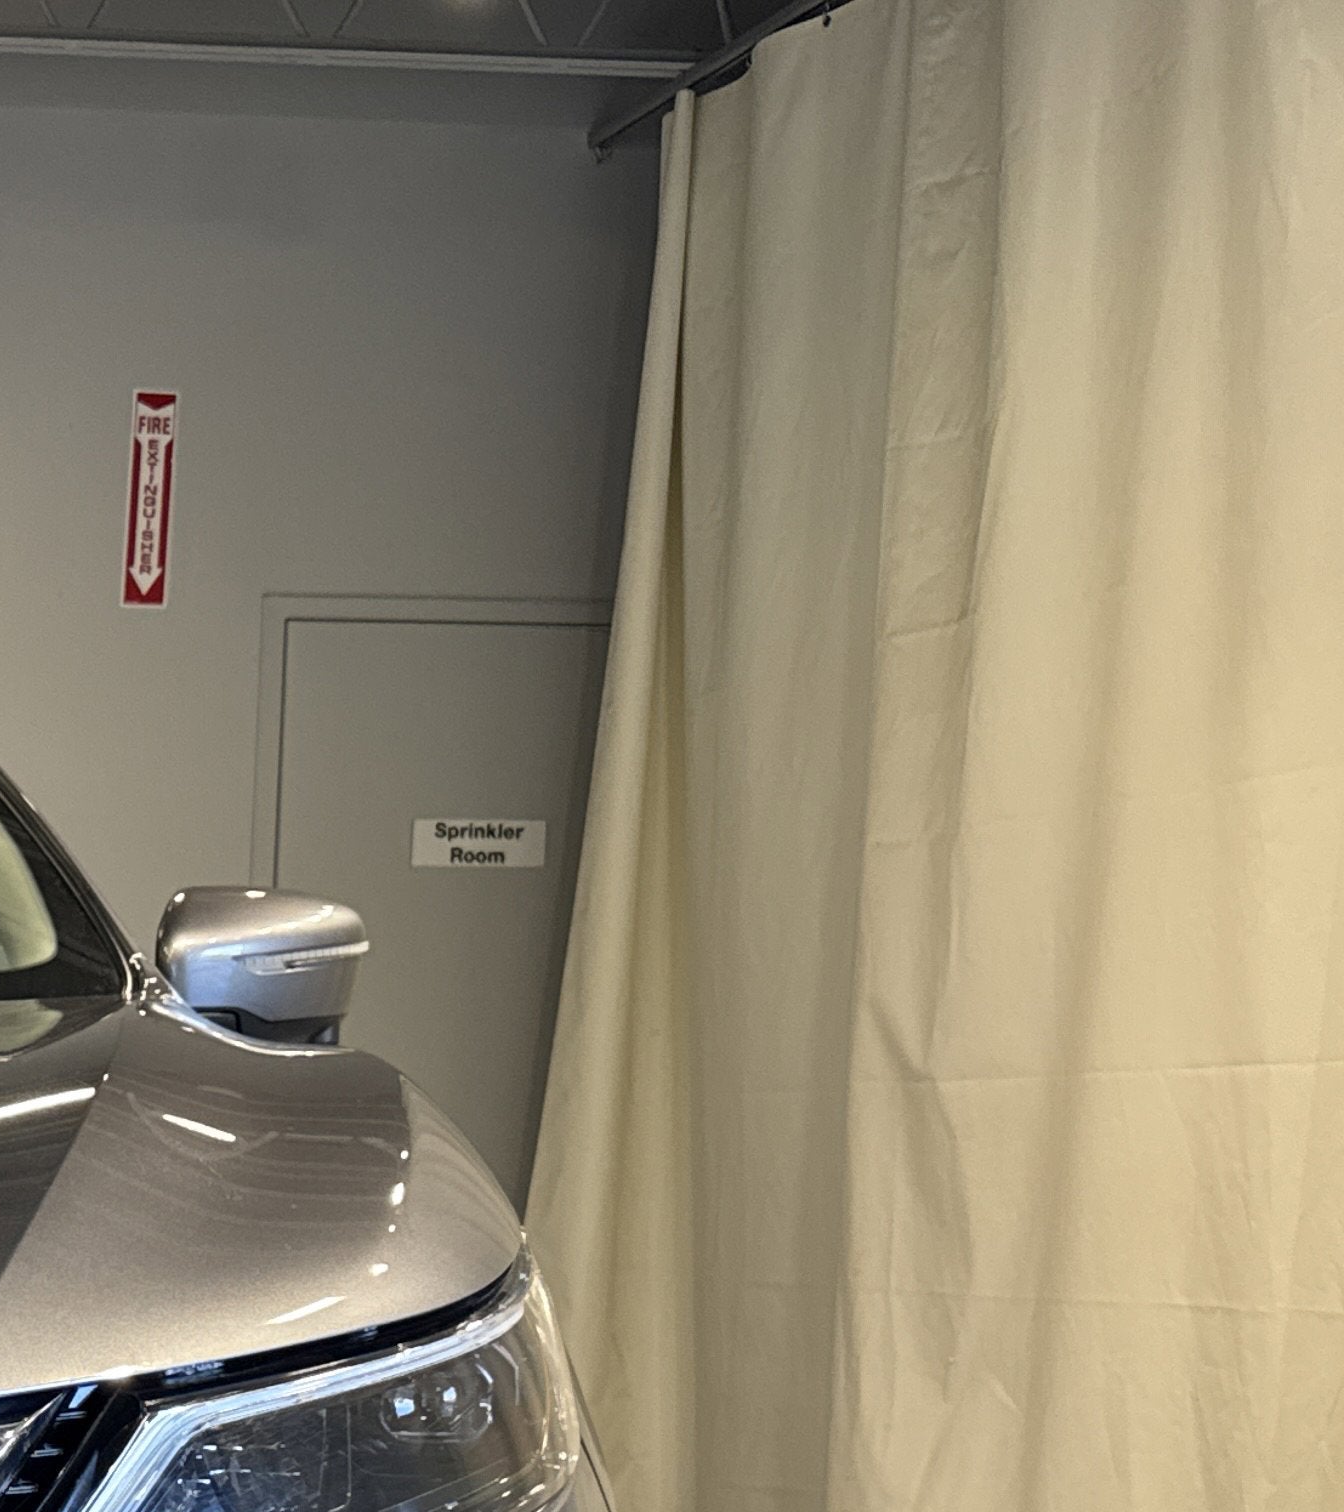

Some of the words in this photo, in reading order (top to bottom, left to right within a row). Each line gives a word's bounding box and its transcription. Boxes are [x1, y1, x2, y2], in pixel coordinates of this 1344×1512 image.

[138, 416, 171, 435] FIRE
[139, 438, 160, 576] EXTINGUISHER
[434, 822, 525, 841] Sprinkler
[450, 847, 505, 864] Room
